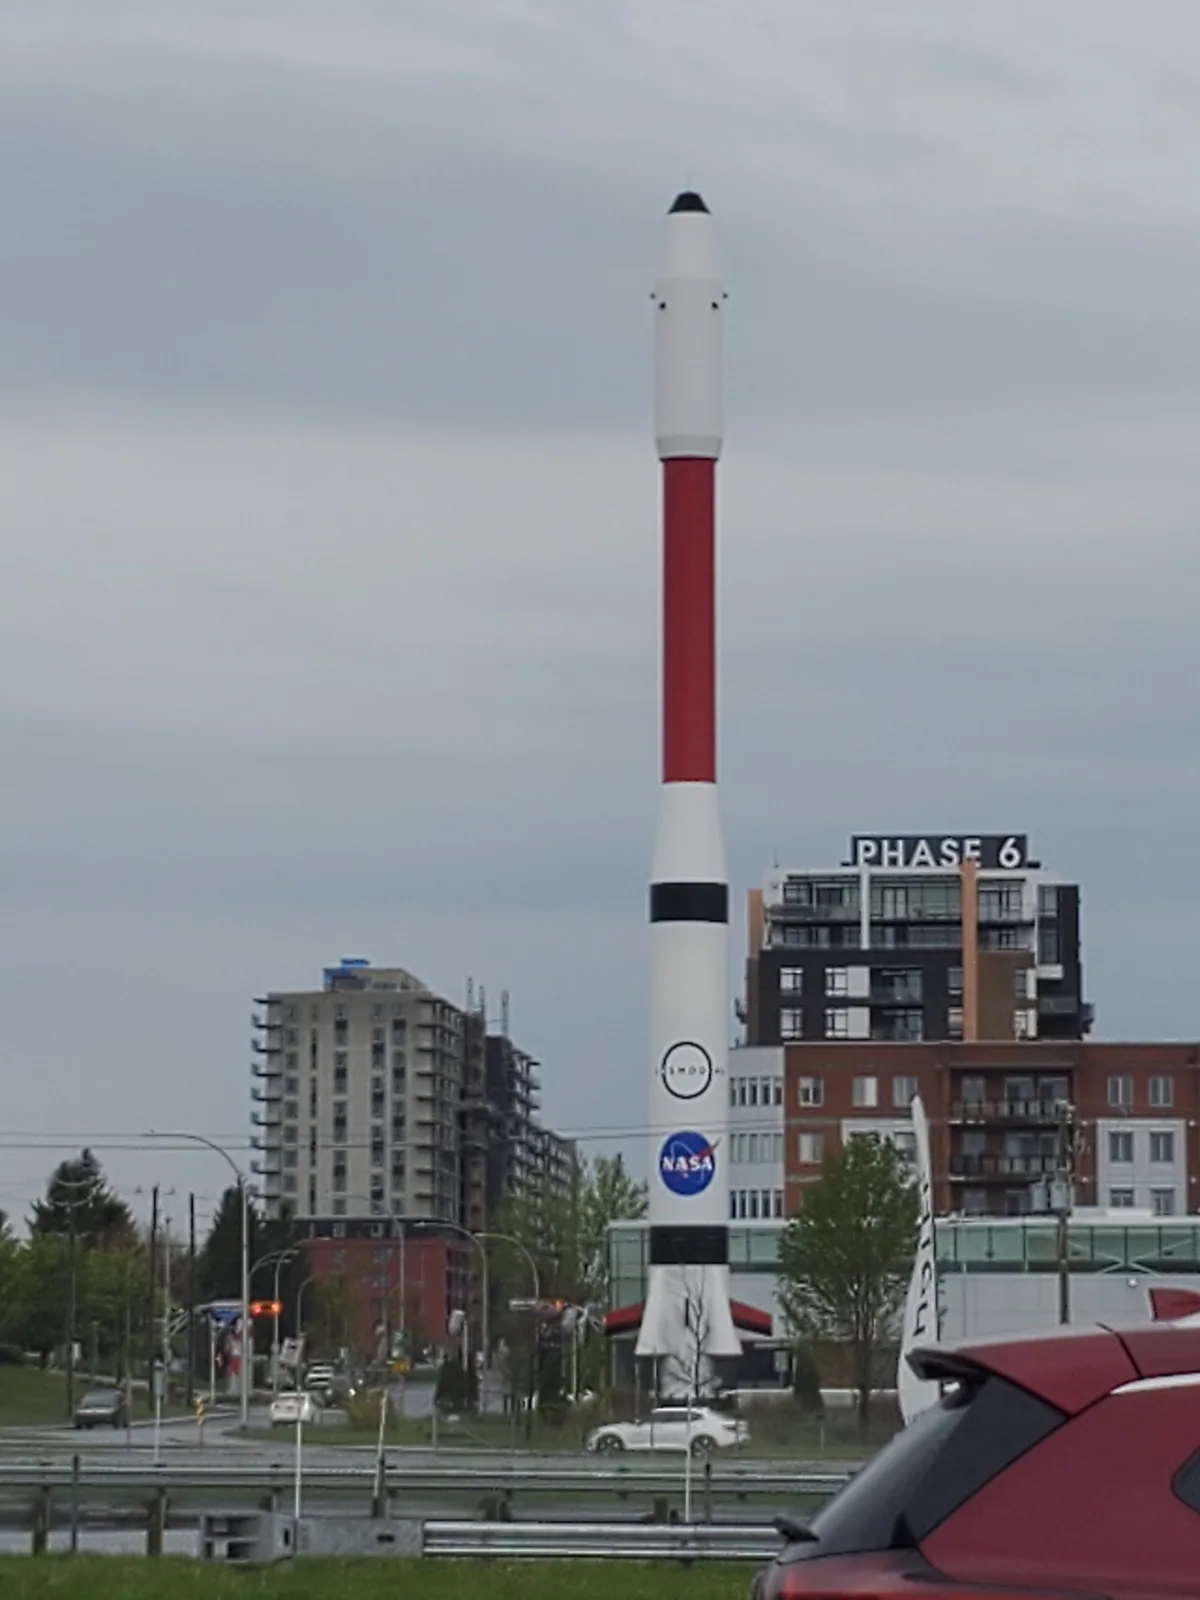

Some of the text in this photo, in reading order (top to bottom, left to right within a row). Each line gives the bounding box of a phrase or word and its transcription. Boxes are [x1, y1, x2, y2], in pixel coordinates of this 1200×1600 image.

[856, 837, 1021, 869] PHASE 6
[662, 1156, 713, 1172] NASA
